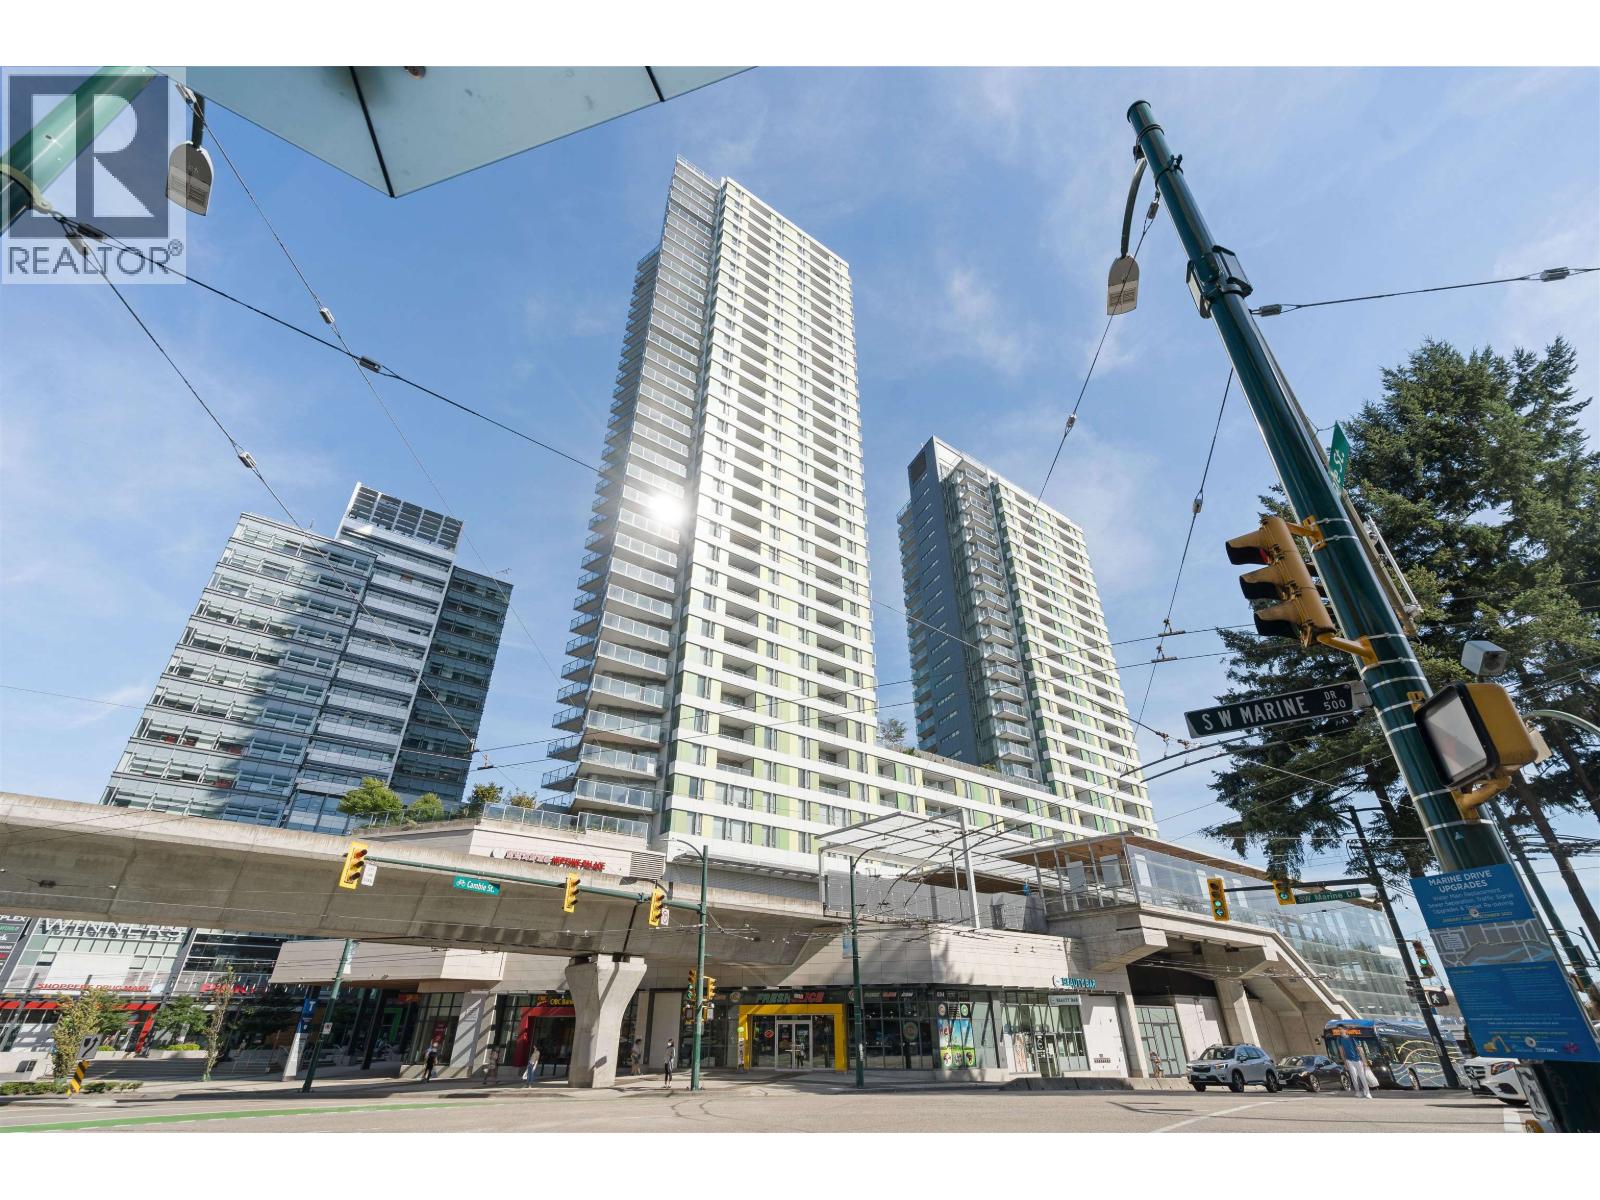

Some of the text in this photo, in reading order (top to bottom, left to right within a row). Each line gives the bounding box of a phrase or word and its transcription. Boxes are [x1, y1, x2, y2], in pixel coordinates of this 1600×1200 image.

[1324, 690, 1337, 700] DR
[1324, 699, 1346, 711] 500
[1202, 696, 1309, 731] S W MARINE
[1428, 870, 1492, 886] MARINE DRIVE
[467, 881, 486, 891] Cambie
[1439, 880, 1488, 893] UPGRADES
[1315, 892, 1343, 901] Marine
[1346, 890, 1357, 898] Dr
[44, 918, 184, 937] WINNERS
[1061, 977, 1096, 989] BEAUTY BAR
[309, 1001, 316, 1011] T
